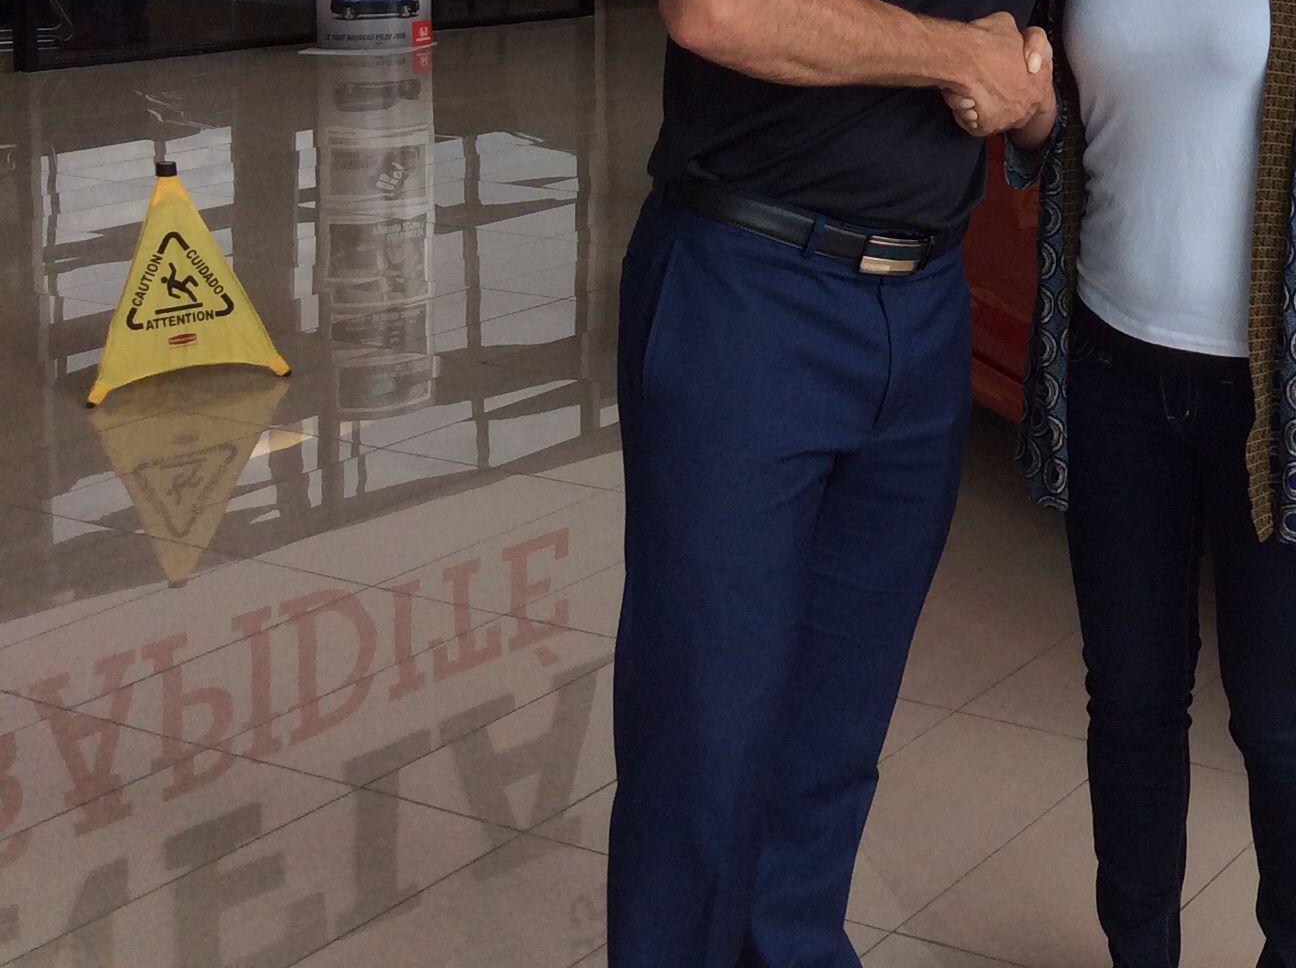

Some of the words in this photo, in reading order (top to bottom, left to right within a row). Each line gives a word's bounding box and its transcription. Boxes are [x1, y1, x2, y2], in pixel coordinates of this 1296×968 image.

[132, 253, 163, 307] CAUTION
[186, 249, 224, 296] CUIDADO
[145, 309, 215, 331] ATTENTION
